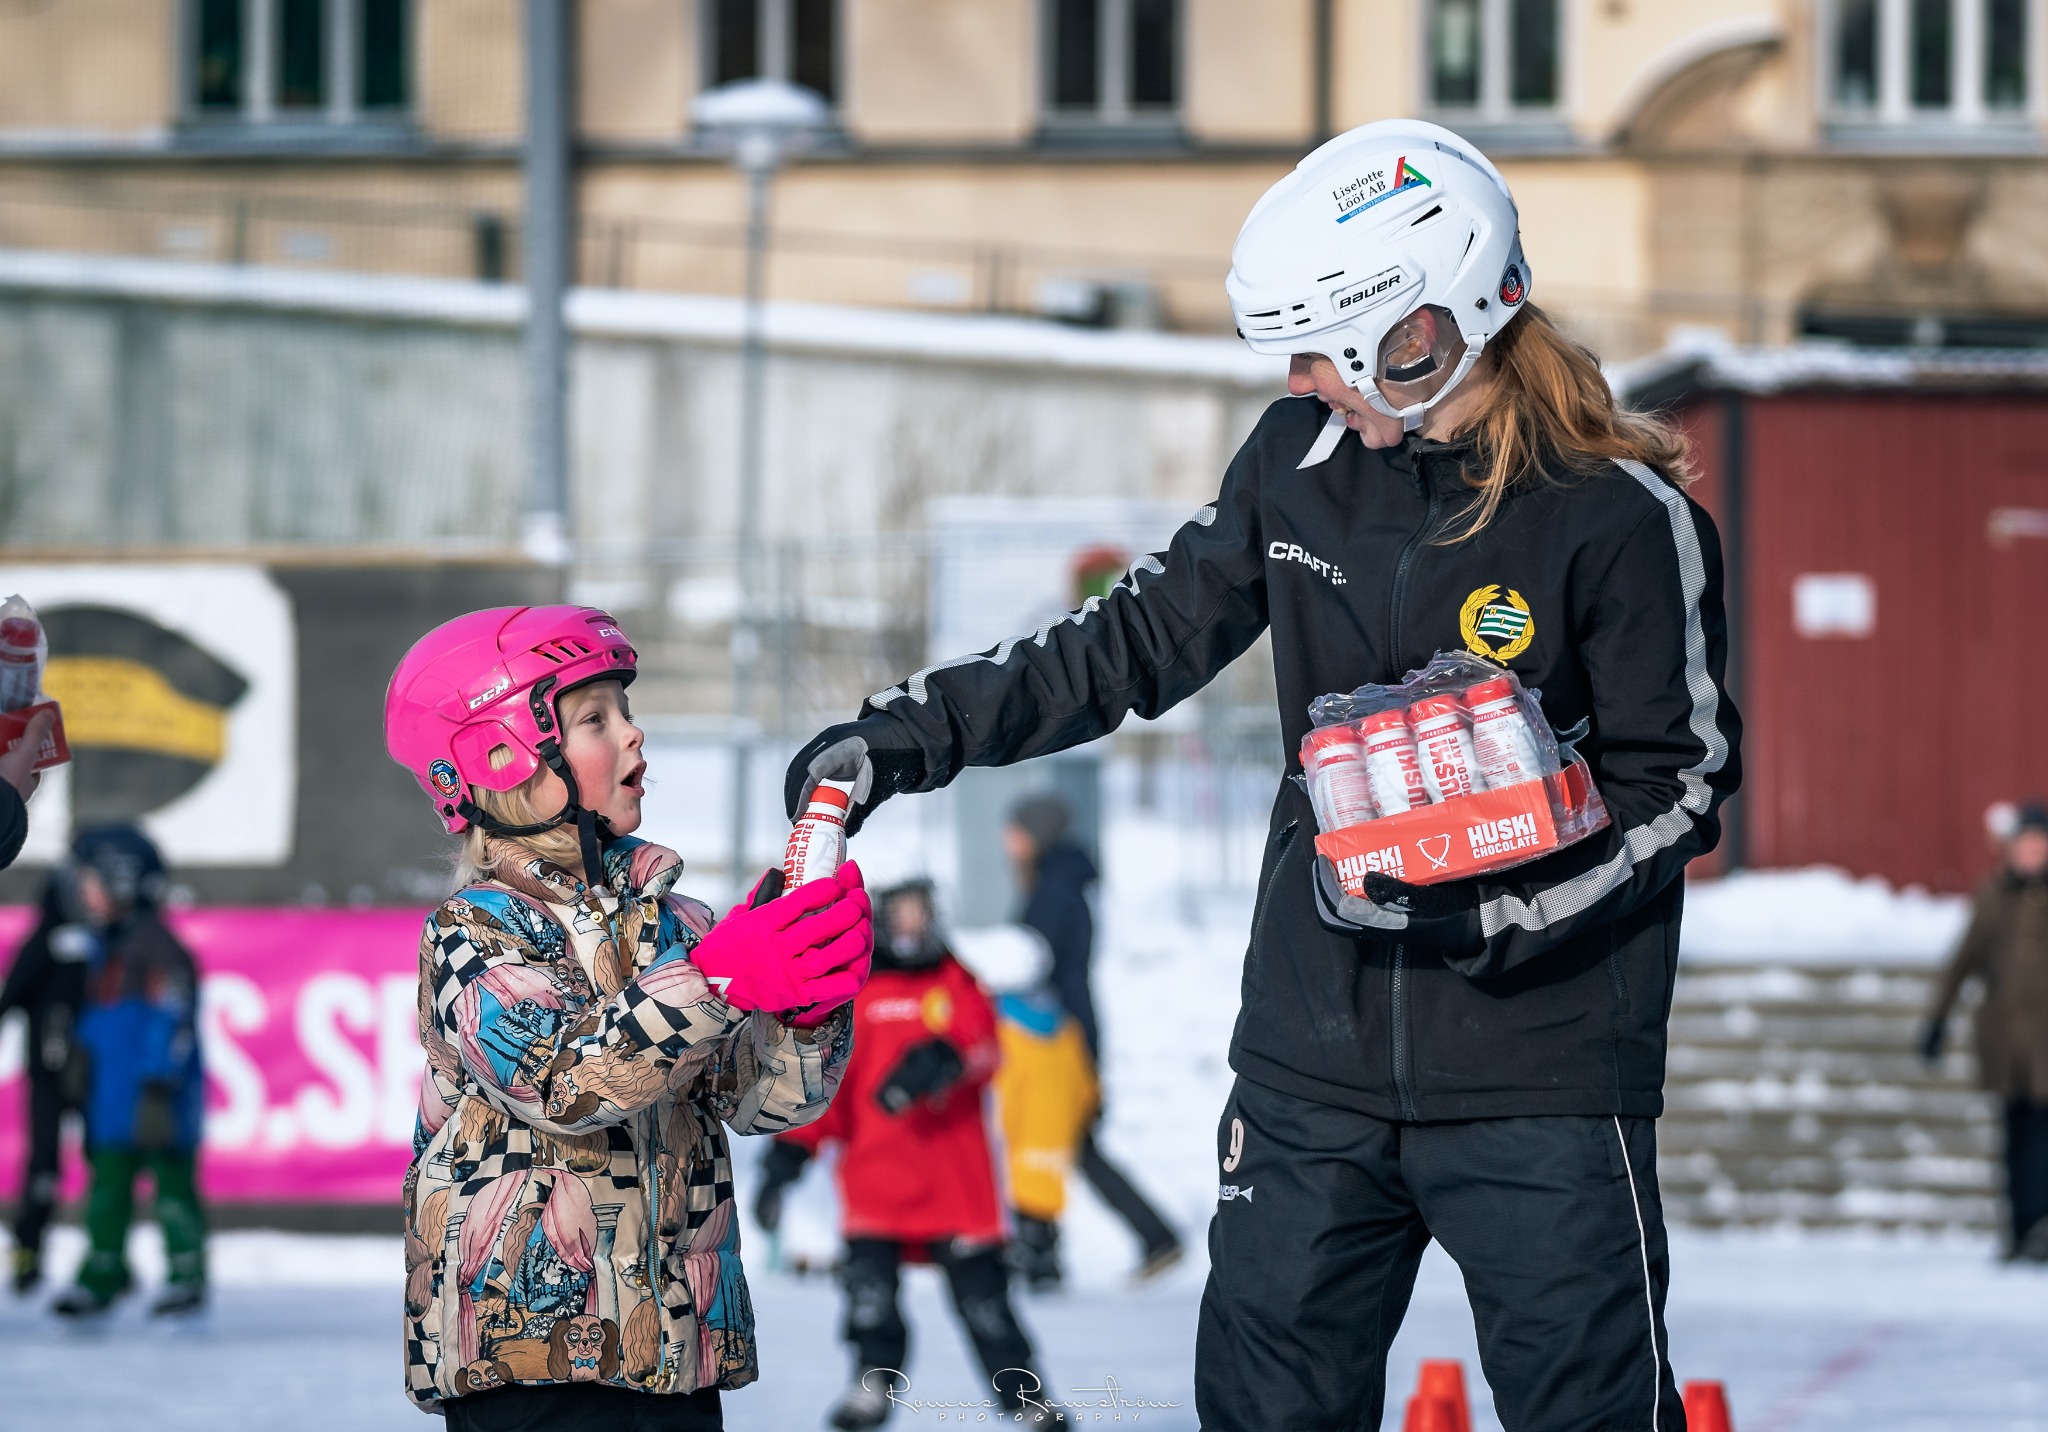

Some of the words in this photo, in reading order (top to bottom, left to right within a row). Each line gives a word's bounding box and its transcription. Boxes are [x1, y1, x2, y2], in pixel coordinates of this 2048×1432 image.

[1332, 169, 1384, 201] Liselotte
[1337, 189, 1366, 213] Lööf
[1369, 180, 1387, 197] AB
[1268, 541, 1331, 578] CRAFT
[598, 628, 621, 638] CC
[468, 677, 511, 710] CCM
[1396, 749, 1429, 809] USKI
[1447, 736, 1473, 798] HOCOLATE
[1466, 812, 1538, 849] HUSKI
[1472, 834, 1540, 859] CHOCOLATE
[793, 823, 815, 889] CHOCOLATE
[1336, 845, 1404, 882] HUSKI
[1341, 866, 1406, 892] CHOATE
[1223, 1117, 1245, 1173] 9
